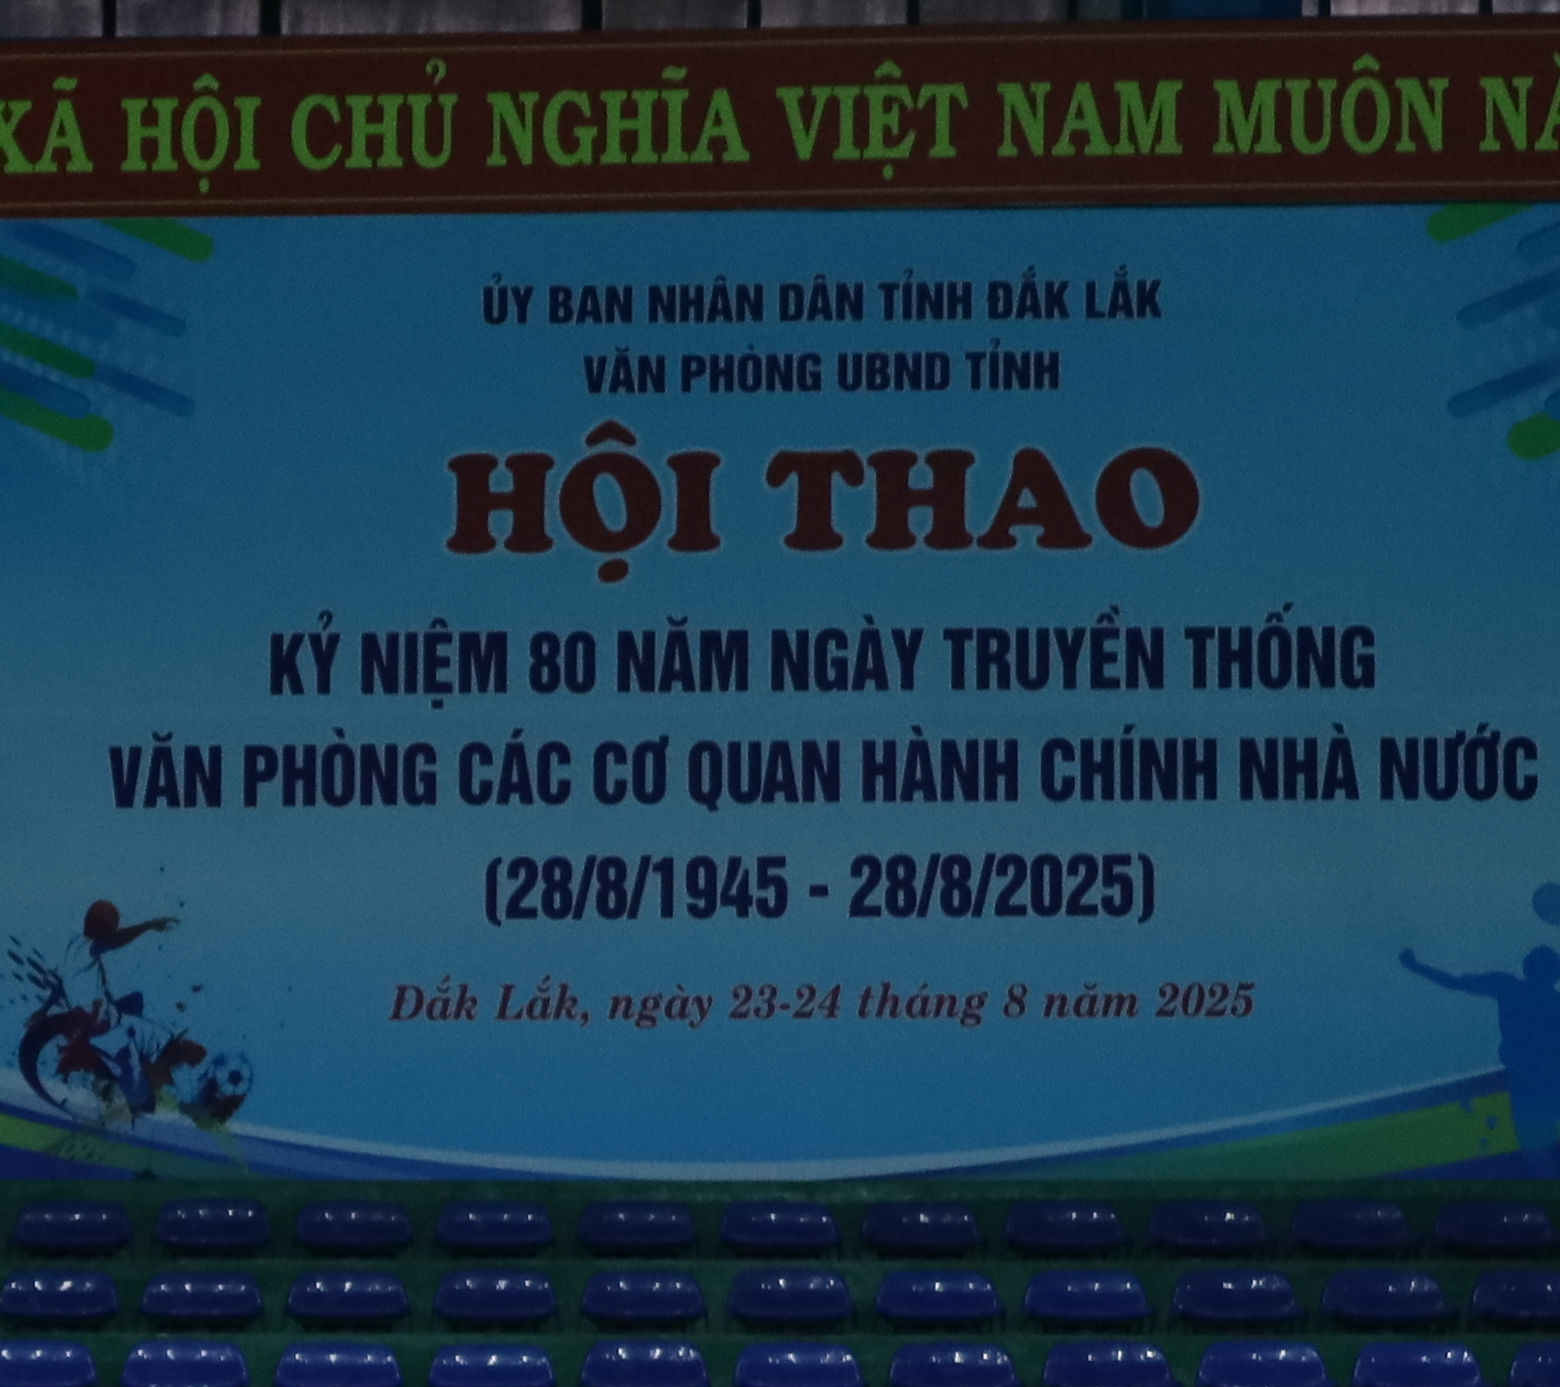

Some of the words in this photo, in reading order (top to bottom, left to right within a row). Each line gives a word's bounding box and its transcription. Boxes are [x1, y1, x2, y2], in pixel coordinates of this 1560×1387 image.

[120, 72, 263, 195] HỘI
[290, 57, 459, 173] CHỦ
[485, 64, 752, 168] NGHĨA
[774, 58, 970, 181] VIỆT
[996, 78, 1184, 158] NAM
[1211, 52, 1450, 156] MUÔN
[483, 273, 534, 325] ỦY
[549, 285, 633, 324] BAN
[648, 275, 764, 324] NHÂN
[779, 274, 864, 322] DÂN
[878, 269, 973, 321] TỈNH
[987, 266, 1070, 320] ĐẮK
[1085, 265, 1162, 319] LẮK
[583, 347, 666, 394] VĂN
[681, 344, 822, 393] PHÒNG
[837, 351, 951, 392] UBND
[965, 338, 1060, 391] TỈNH
[446, 420, 721, 583] HỘI
[766, 447, 1200, 552] THAO
[270, 610, 341, 695] KỶ
[361, 618, 508, 709] NIỆM
[529, 631, 596, 694] 80
[617, 616, 749, 693] NĂM
[771, 614, 924, 692] NGÀY
[943, 605, 1165, 691] TRUYỀN
[1184, 602, 1376, 690] THỐNG
[109, 732, 223, 809] VĂN
[243, 727, 437, 808] PHÒNG
[459, 728, 572, 806] CÁC
[593, 735, 670, 805] CƠ
[688, 740, 841, 812] QUAN
[862, 725, 1019, 803] HÀNH
[1040, 723, 1218, 802] CHÍNH
[1239, 723, 1360, 801] NHÀ
[1379, 722, 1539, 802] NƯỚC
[484, 854, 789, 927] (28/8/1945
[809, 884, 829, 898] -
[849, 853, 1155, 924] 28/8/2025)
[495, 974, 590, 1027] Lắk,
[608, 984, 714, 1030] ngày
[728, 983, 842, 1020] 23-24
[857, 981, 989, 1028] tháng
[1002, 982, 1029, 1019] 8
[1043, 982, 1139, 1019] năm
[1154, 981, 1256, 1019] 2025
